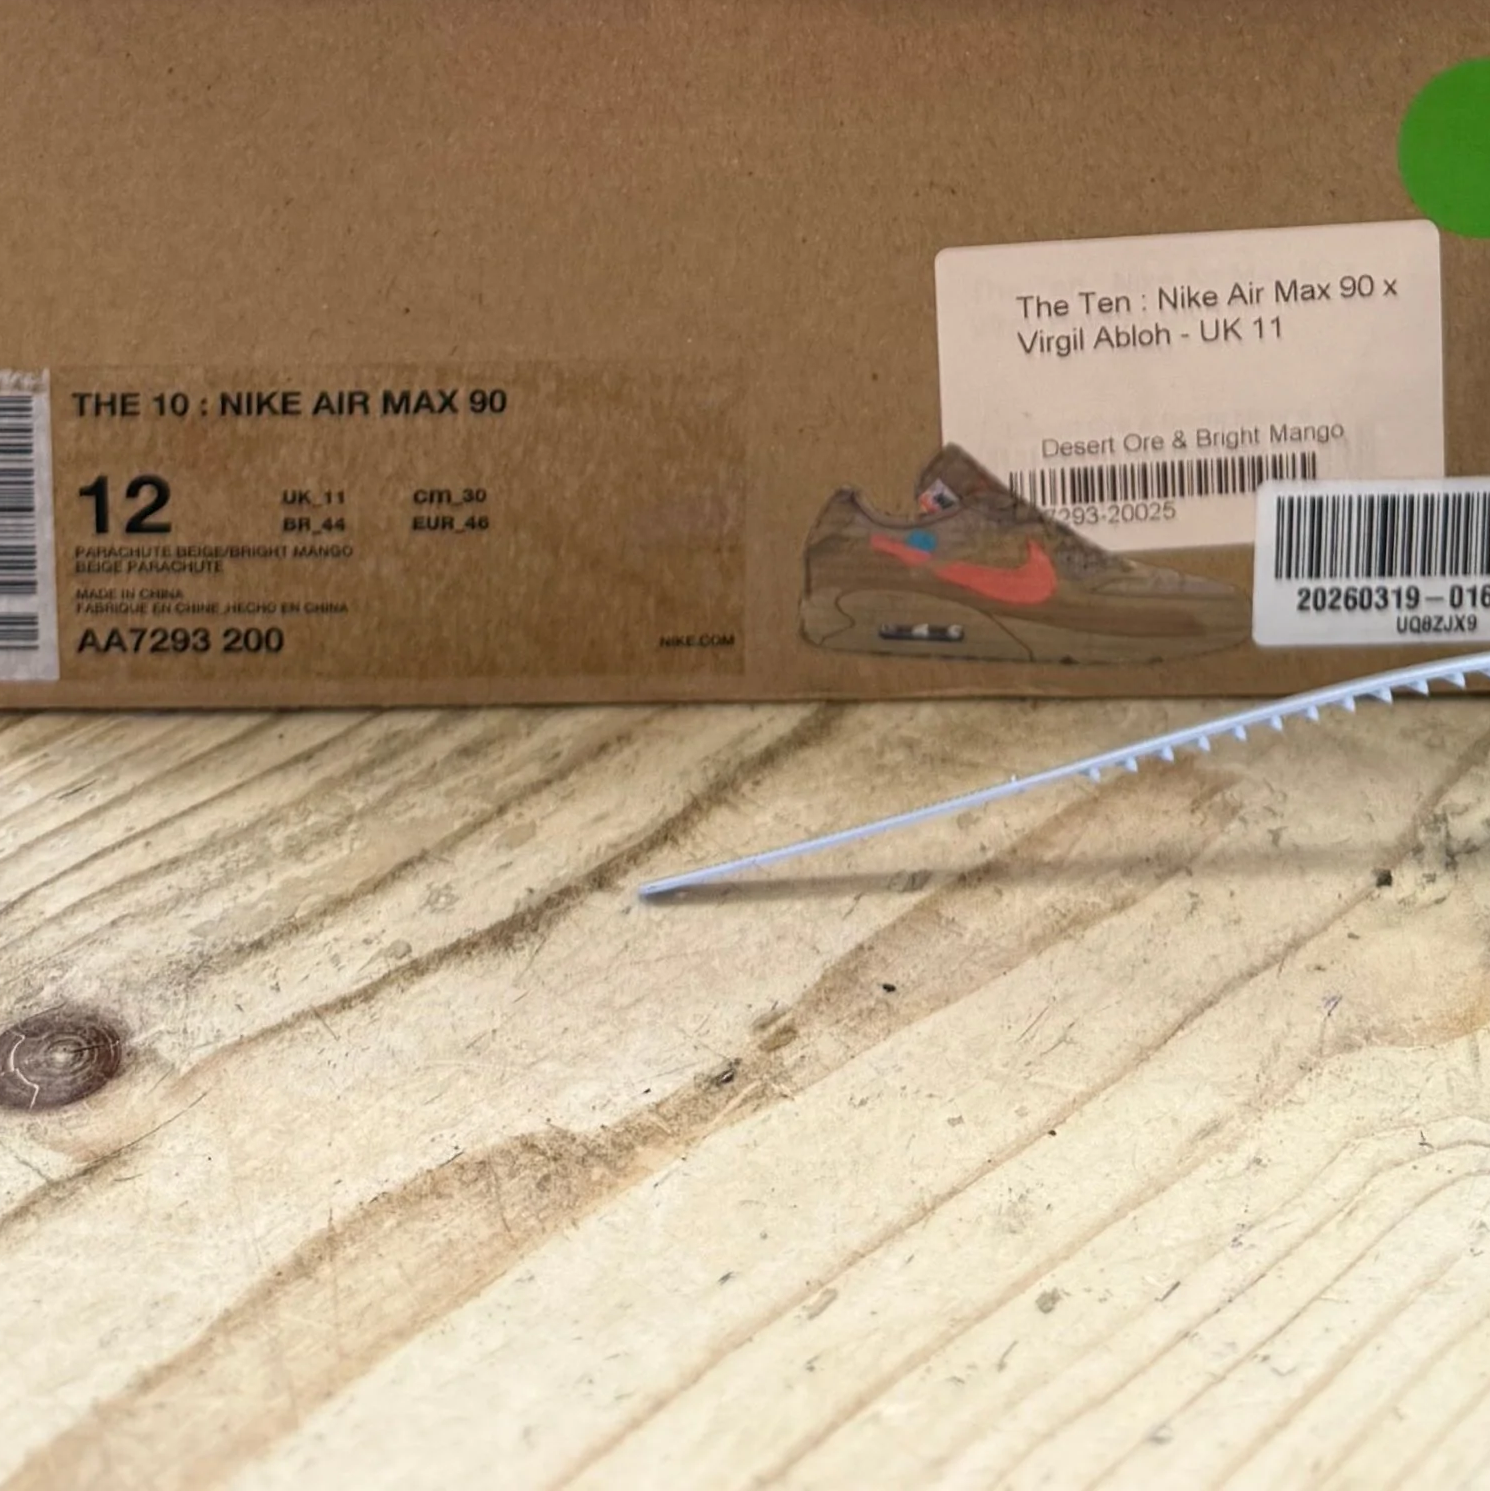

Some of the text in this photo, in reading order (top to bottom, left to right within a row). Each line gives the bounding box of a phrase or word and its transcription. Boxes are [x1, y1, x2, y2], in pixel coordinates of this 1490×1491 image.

[1016, 295, 1069, 319] The
[1079, 291, 1131, 315] Ten
[1158, 286, 1218, 310] Nike
[1227, 281, 1264, 305] Air
[1275, 279, 1331, 303] Max
[1339, 275, 1374, 298] 90
[1383, 277, 1398, 296] x
[1018, 329, 1085, 357] Virgil
[1094, 322, 1171, 349] Abloh
[1200, 317, 1242, 342] UK
[1253, 316, 1283, 338] 11
[72, 392, 141, 417] THE
[153, 392, 189, 416] 10
[220, 390, 302, 415] NIKE
[313, 390, 370, 415] AIR
[382, 389, 459, 414] MAX
[469, 389, 507, 414] 90
[1042, 422, 1345, 458] Desert Ore & Bright Mango
[78, 474, 172, 534] 12
[283, 489, 346, 508] UK_11
[283, 516, 346, 535] BR_44
[75, 544, 354, 559] PARACHUTE BEIGE/BRIGHT MANGO
[75, 560, 224, 574] BEIGE PARACHUTE
[76, 588, 184, 600] MADE IN CHINA
[152, 602, 172, 615] EN
[175, 602, 219, 615] CHINE
[281, 602, 301, 615] EN
[304, 601, 349, 615] CHINA
[1396, 613, 1478, 634] UQ8ZJX9
[76, 627, 284, 654] AA7293 200
